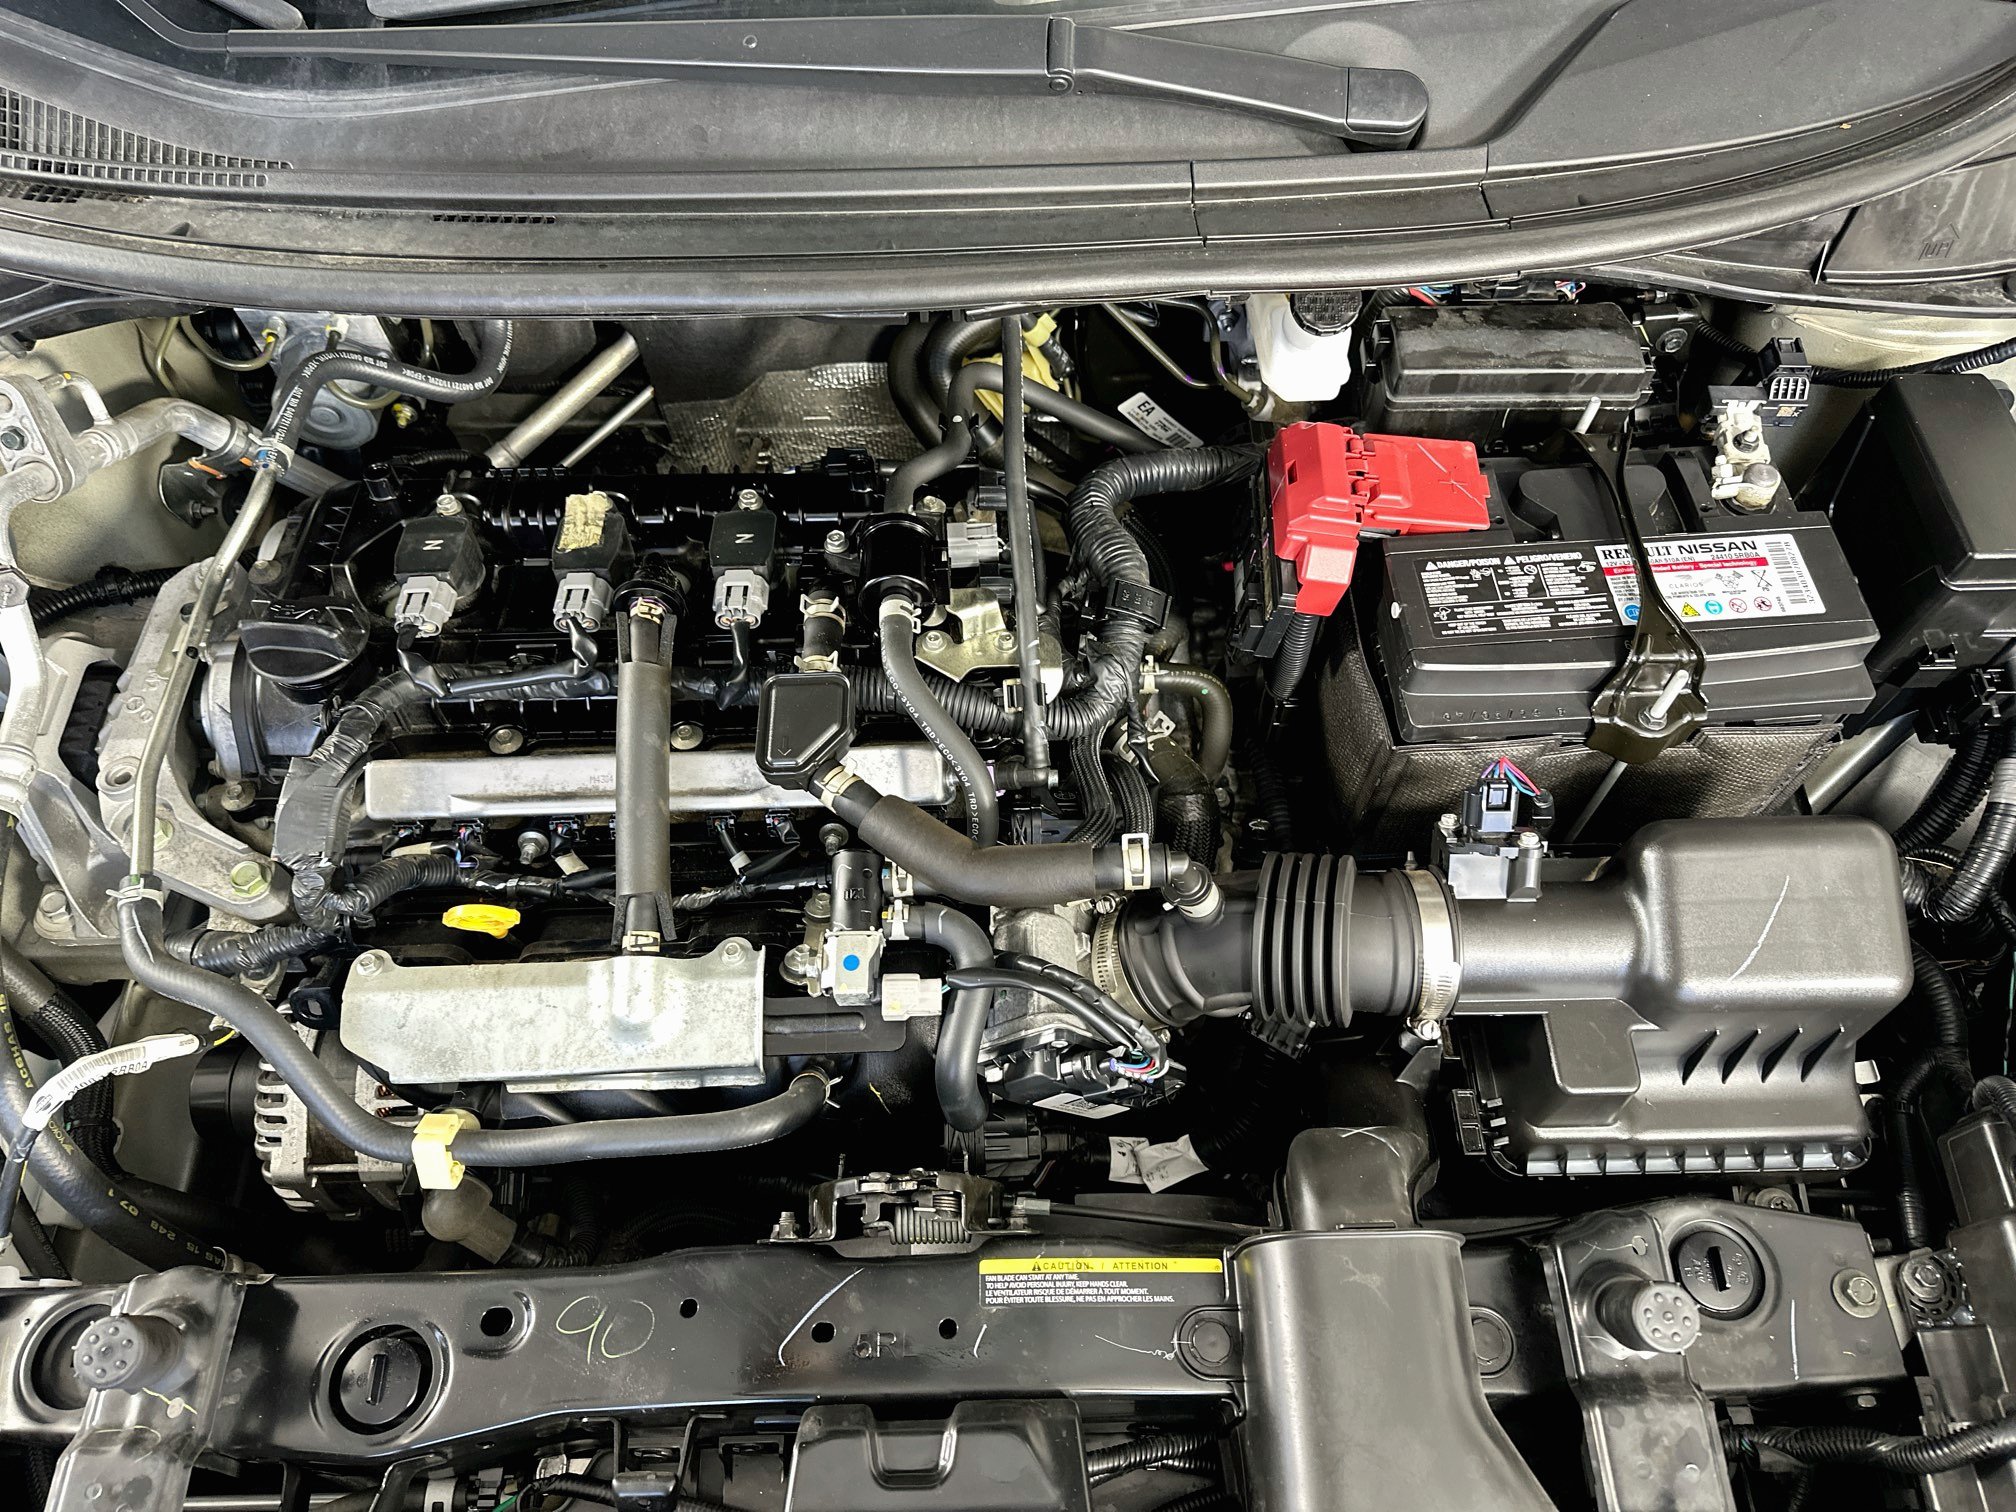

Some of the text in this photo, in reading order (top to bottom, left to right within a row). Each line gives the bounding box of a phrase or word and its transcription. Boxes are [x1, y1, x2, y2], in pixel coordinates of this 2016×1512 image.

[1137, 400, 1156, 417] EA
[1601, 540, 1758, 560] REULT NISSAN
[1669, 581, 1704, 589] CLARIOS
[1043, 1262, 1091, 1270] CAUTION
[1113, 1261, 1168, 1270] ATTENTION
[1065, 1287, 1097, 1295] DÉMARRER
[1004, 1296, 1024, 1304] ÉVITER
[556, 1295, 655, 1365] 90
